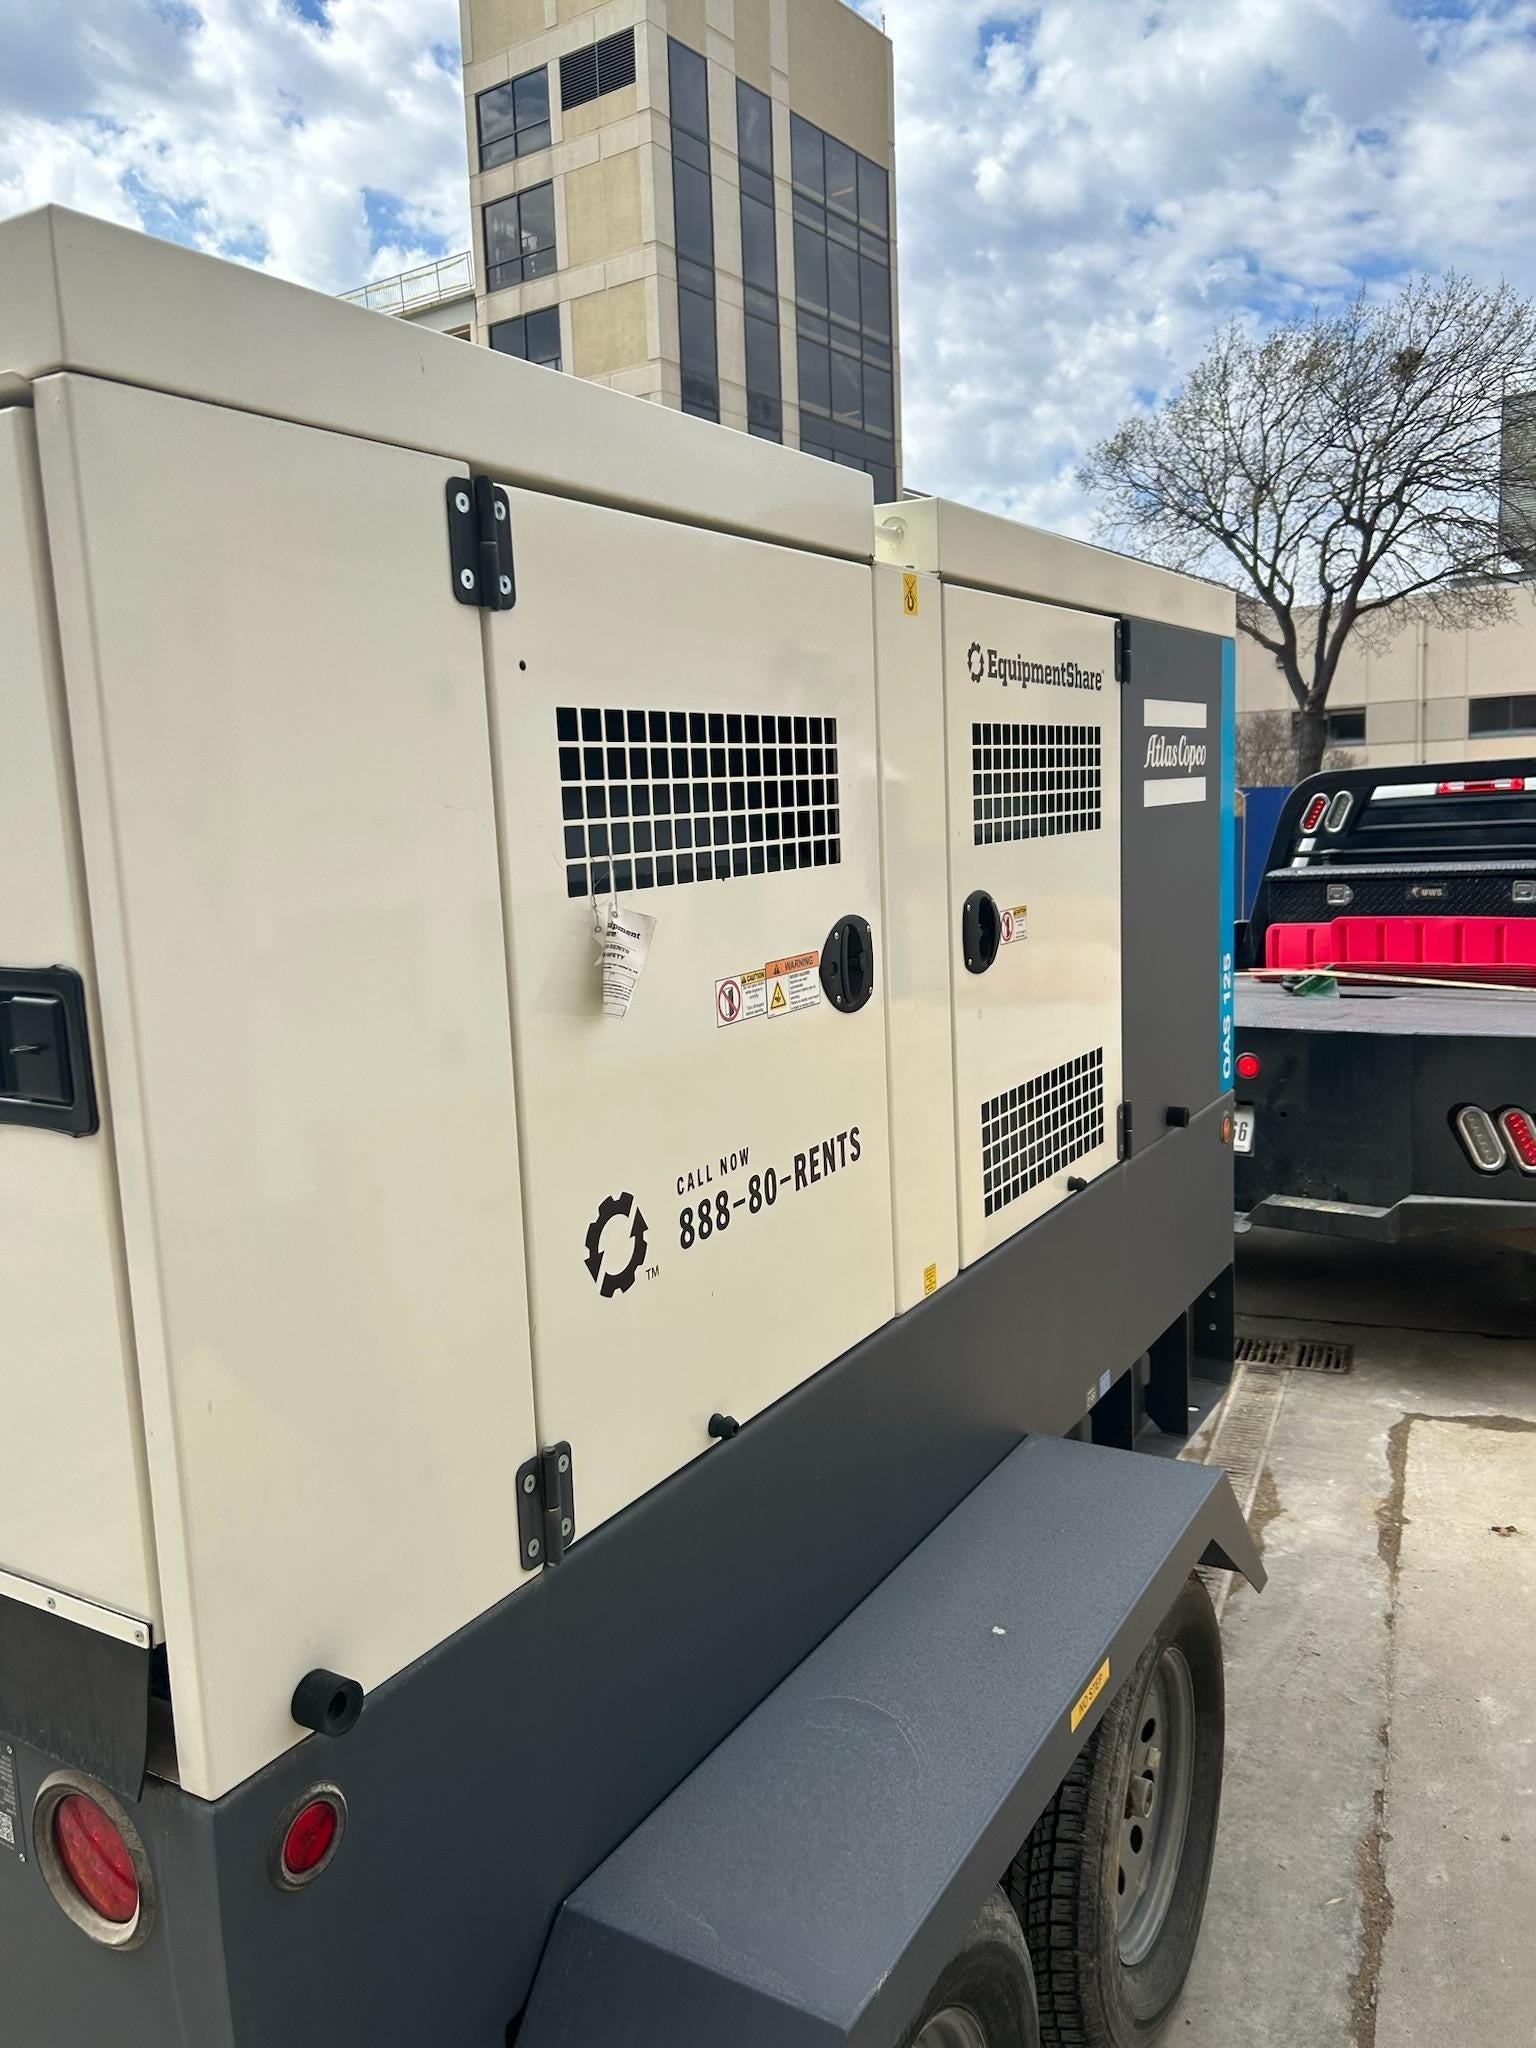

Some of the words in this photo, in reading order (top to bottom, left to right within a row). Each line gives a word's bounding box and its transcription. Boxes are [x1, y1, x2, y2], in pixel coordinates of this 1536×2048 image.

[987, 649, 1102, 691] EquipmentShare
[1144, 734, 1178, 768] Atlas
[1179, 735, 1207, 773] Copco
[746, 971, 765, 981] CAUTION
[784, 955, 814, 971] WARNING
[1222, 953, 1232, 1004] 125
[676, 1165, 713, 1195] CALL
[720, 1147, 749, 1176] NOW
[679, 1126, 862, 1250] 888-80-RENTS
